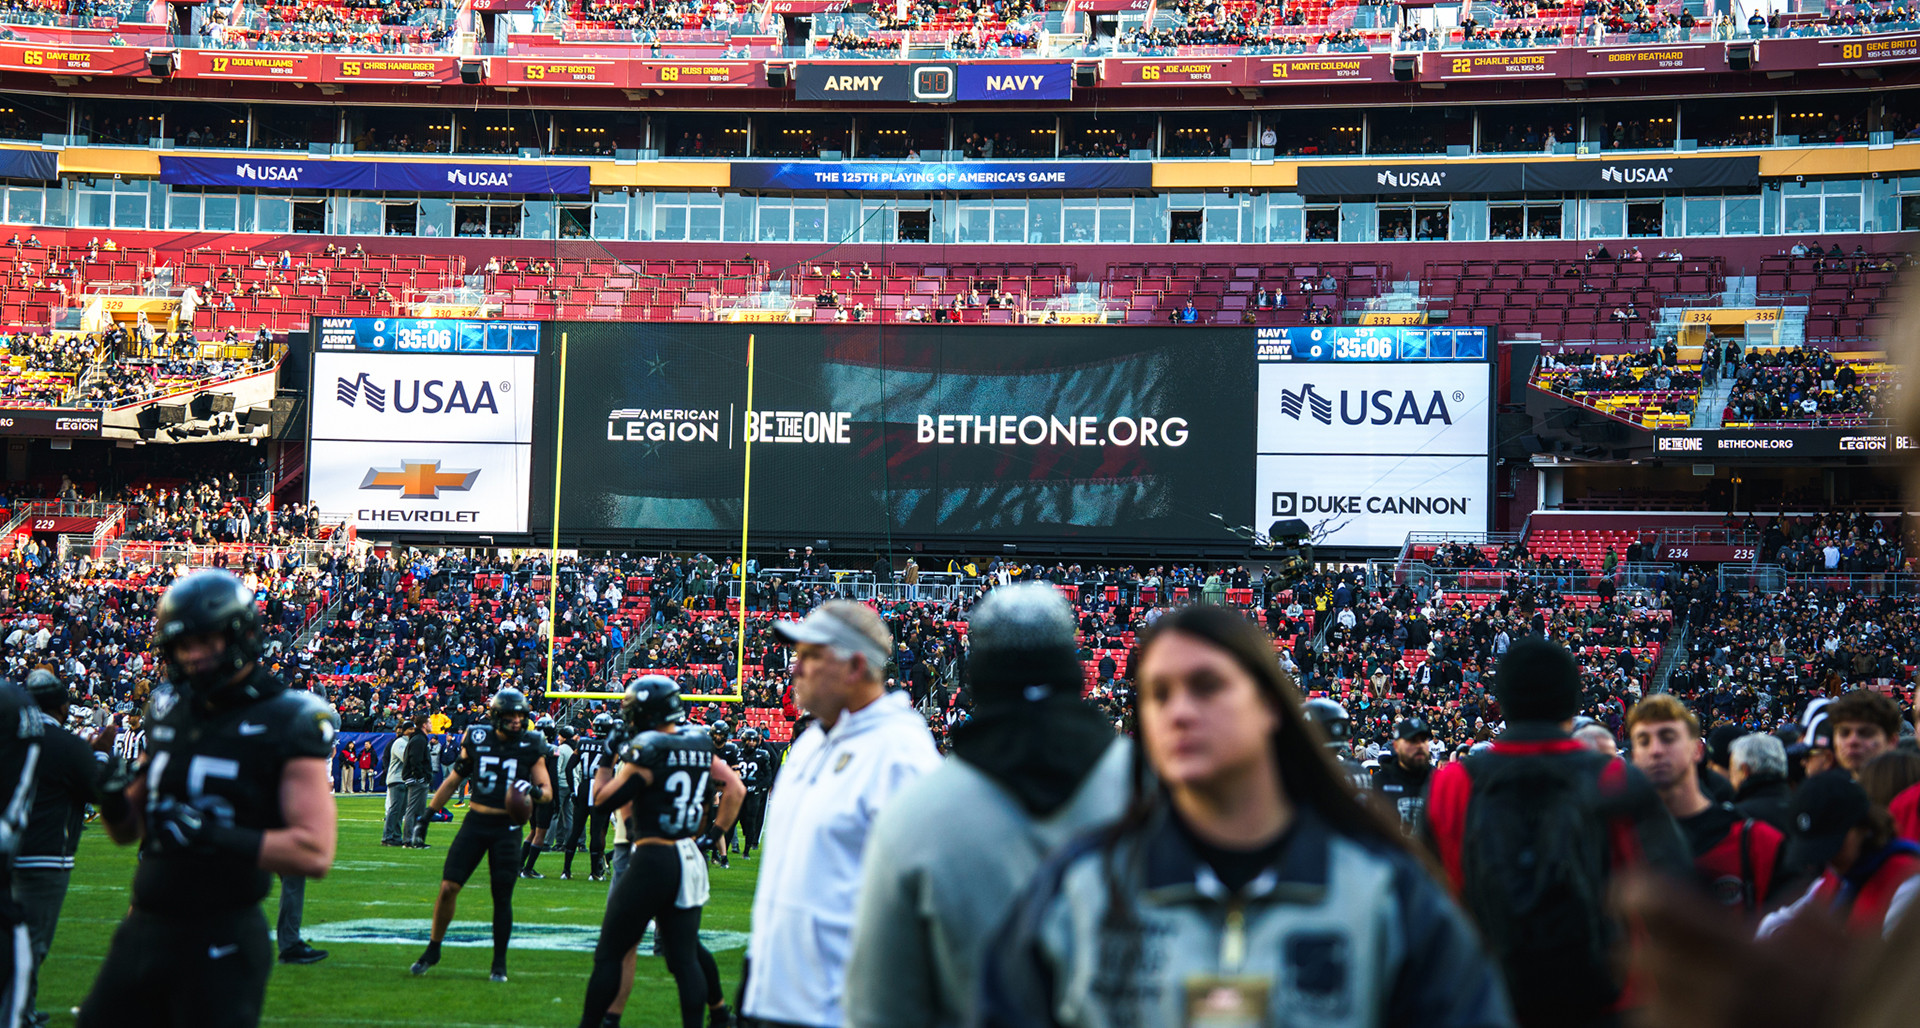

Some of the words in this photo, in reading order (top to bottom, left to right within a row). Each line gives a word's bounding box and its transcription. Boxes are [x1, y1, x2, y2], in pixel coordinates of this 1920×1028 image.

[473, 0, 491, 8] 439
[774, 3, 792, 11] 440
[1077, 1, 1095, 10] 441
[1130, 0, 1148, 9] 442
[1866, 41, 1890, 51] GENE
[1891, 39, 1917, 49] BRITO
[46, 52, 68, 61] DAVE
[1608, 53, 1637, 62] BOBBY
[1638, 52, 1683, 61] BEATHARD
[1843, 44, 1862, 59] 80
[24, 50, 43, 65] 65
[231, 58, 254, 66] DOUG
[254, 59, 293, 68] WILLIAMS
[1474, 57, 1510, 66] CHARLIE
[1511, 56, 1545, 64] JUSTICE
[212, 58, 228, 71] 17
[342, 62, 361, 75] 55
[363, 62, 387, 70] CHRIS
[388, 62, 435, 71] HANBURGER
[548, 65, 567, 73] JEFF
[568, 66, 595, 74] BOSTIC
[1163, 65, 1179, 73] JOE
[1180, 65, 1211, 73] JACOBY
[1291, 62, 1319, 71] MONTE
[1321, 61, 1360, 70] COLEMAN
[1452, 58, 1471, 73] 22
[527, 65, 545, 79] 53
[661, 67, 678, 81] 68
[682, 67, 702, 75] RUSS
[703, 67, 729, 75] GRIMM
[1142, 65, 1160, 80] 66
[1272, 63, 1288, 78] 51
[824, 75, 883, 91] ARMY
[921, 73, 946, 91] 40
[986, 75, 1044, 91] NAVY
[815, 172, 839, 182] THE
[841, 172, 878, 182] 125TH
[881, 172, 934, 183] PLAYING
[937, 172, 956, 183] OF
[958, 172, 1026, 183] AMERICA'S
[1028, 172, 1066, 182] GAME
[105, 301, 123, 310] 329
[1373, 317, 1391, 325] 333
[1693, 313, 1712, 322] 334
[1755, 312, 1775, 321] 335
[322, 319, 352, 328] NAVY
[374, 320, 385, 331] 0
[415, 320, 436, 329] 1ST
[1257, 328, 1288, 338] NAVY
[1310, 329, 1322, 341] 0
[1354, 328, 1375, 337] 1ST
[322, 335, 354, 344] ARMY
[373, 336, 385, 347] 0
[398, 329, 451, 349] 35:06
[1257, 345, 1290, 354] ARMY
[1310, 345, 1322, 357] 0
[1336, 337, 1391, 358] 35:06
[639, 408, 719, 420] AMERICAN
[55, 422, 98, 431] LEGION
[607, 421, 719, 442] LEGION
[917, 414, 1189, 447] BETHEONE.ORG
[1718, 439, 1793, 449] BETHEONE.ORG
[1839, 441, 1886, 450] LEGION
[1302, 496, 1361, 513] DUKE
[357, 509, 480, 523] CHEVROLET
[34, 519, 55, 529] 229
[1667, 548, 1689, 559] 234
[1733, 549, 1755, 560] 235
[477, 755, 518, 794] 51
